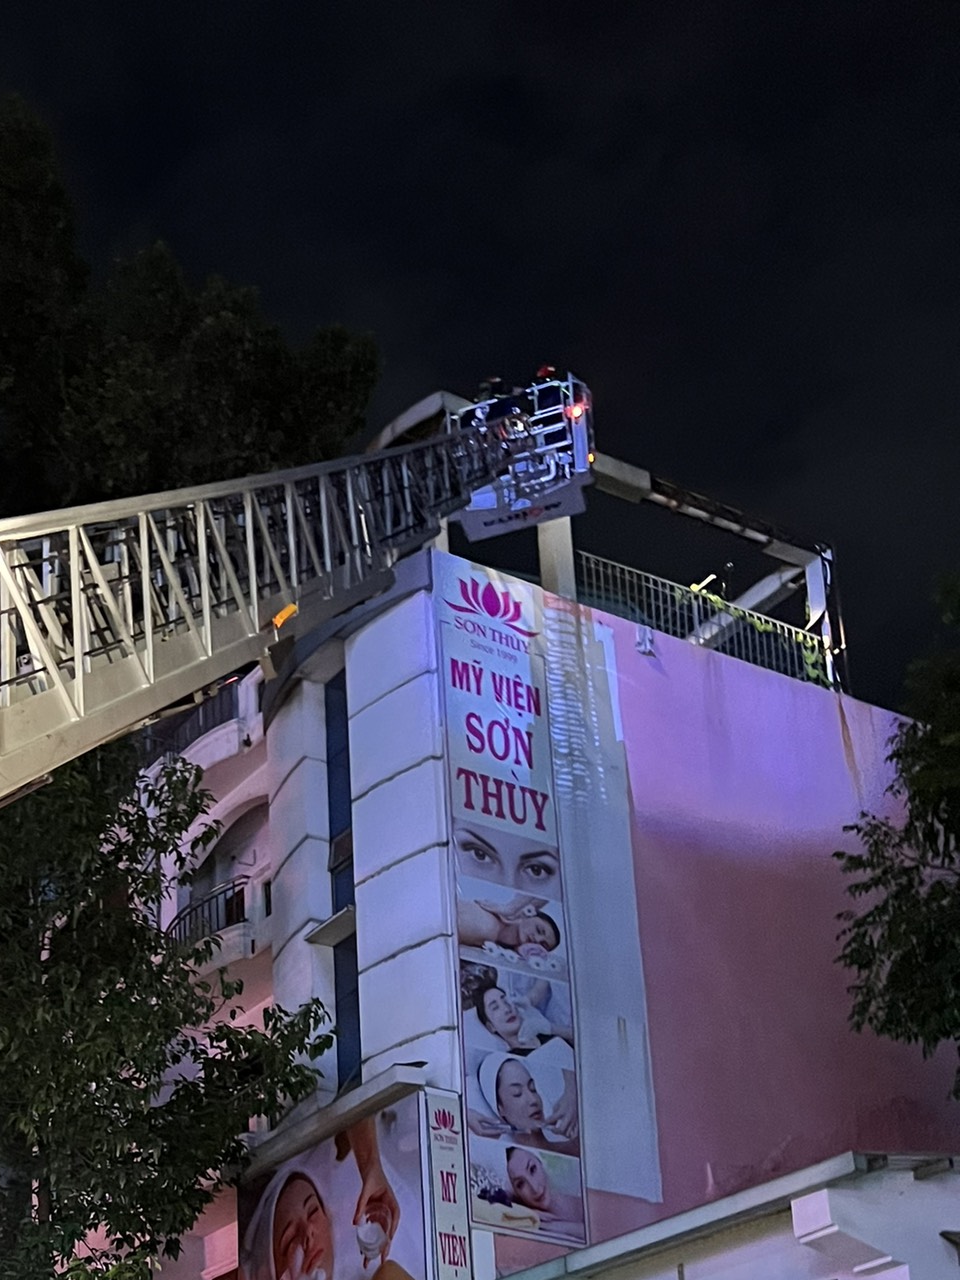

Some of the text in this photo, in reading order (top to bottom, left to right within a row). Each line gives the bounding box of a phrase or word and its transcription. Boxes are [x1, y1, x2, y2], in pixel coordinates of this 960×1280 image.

[451, 657, 542, 718] MỸ VIỆN
[465, 712, 533, 769] SƠN
[456, 767, 549, 832] THÙY
